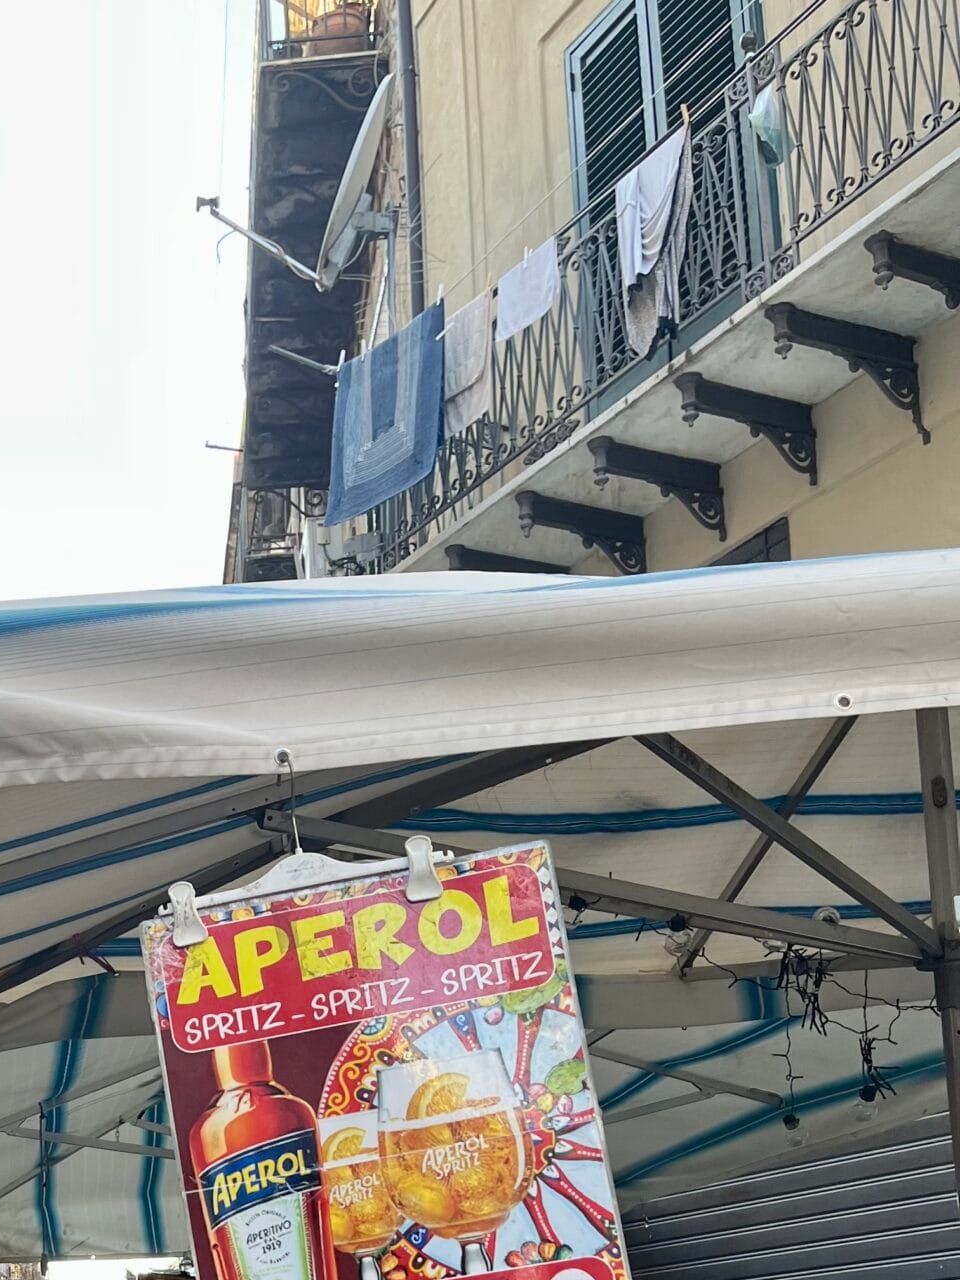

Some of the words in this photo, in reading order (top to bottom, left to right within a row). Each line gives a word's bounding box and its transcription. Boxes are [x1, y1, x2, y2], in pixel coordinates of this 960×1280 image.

[177, 875, 540, 1005] APEROL
[184, 1001, 285, 1045] SPRITZ
[310, 976, 415, 1021] SPRITZ
[440, 951, 548, 996] SPRITZ
[421, 1134, 490, 1174] APEROL
[434, 1152, 481, 1180] SPRITZ
[212, 1149, 313, 1216] APEROL
[329, 1173, 381, 1204] APEROL
[340, 1188, 374, 1209] SPRITZ
[246, 1220, 291, 1245] APERITIVO
[262, 1239, 282, 1254] 1919
